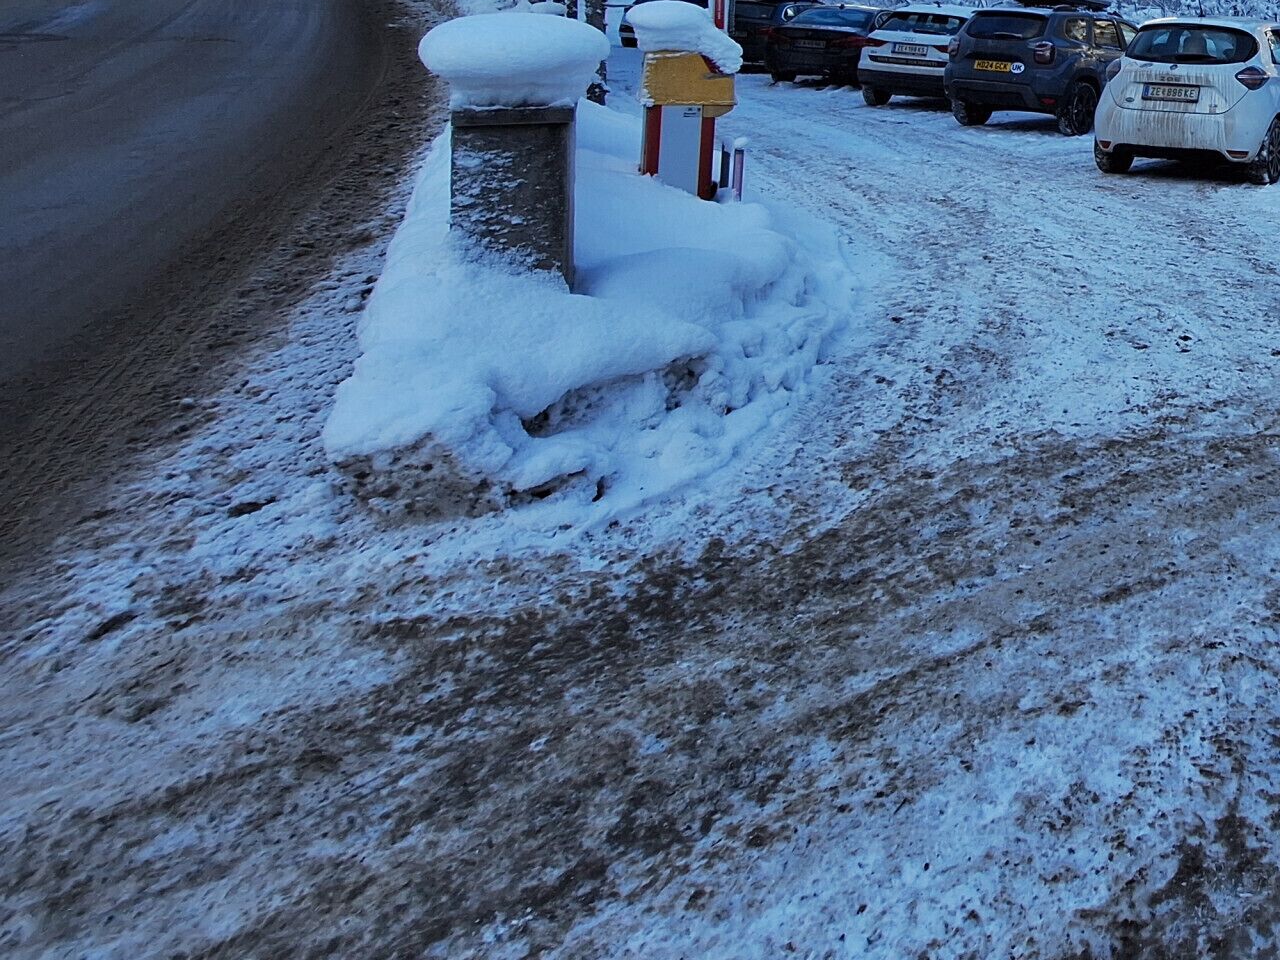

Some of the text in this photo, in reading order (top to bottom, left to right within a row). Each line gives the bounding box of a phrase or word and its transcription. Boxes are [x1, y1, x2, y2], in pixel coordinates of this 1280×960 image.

[1012, 64, 1023, 72] UK
[1150, 87, 1161, 96] ZE
[1183, 88, 1195, 98] KE
